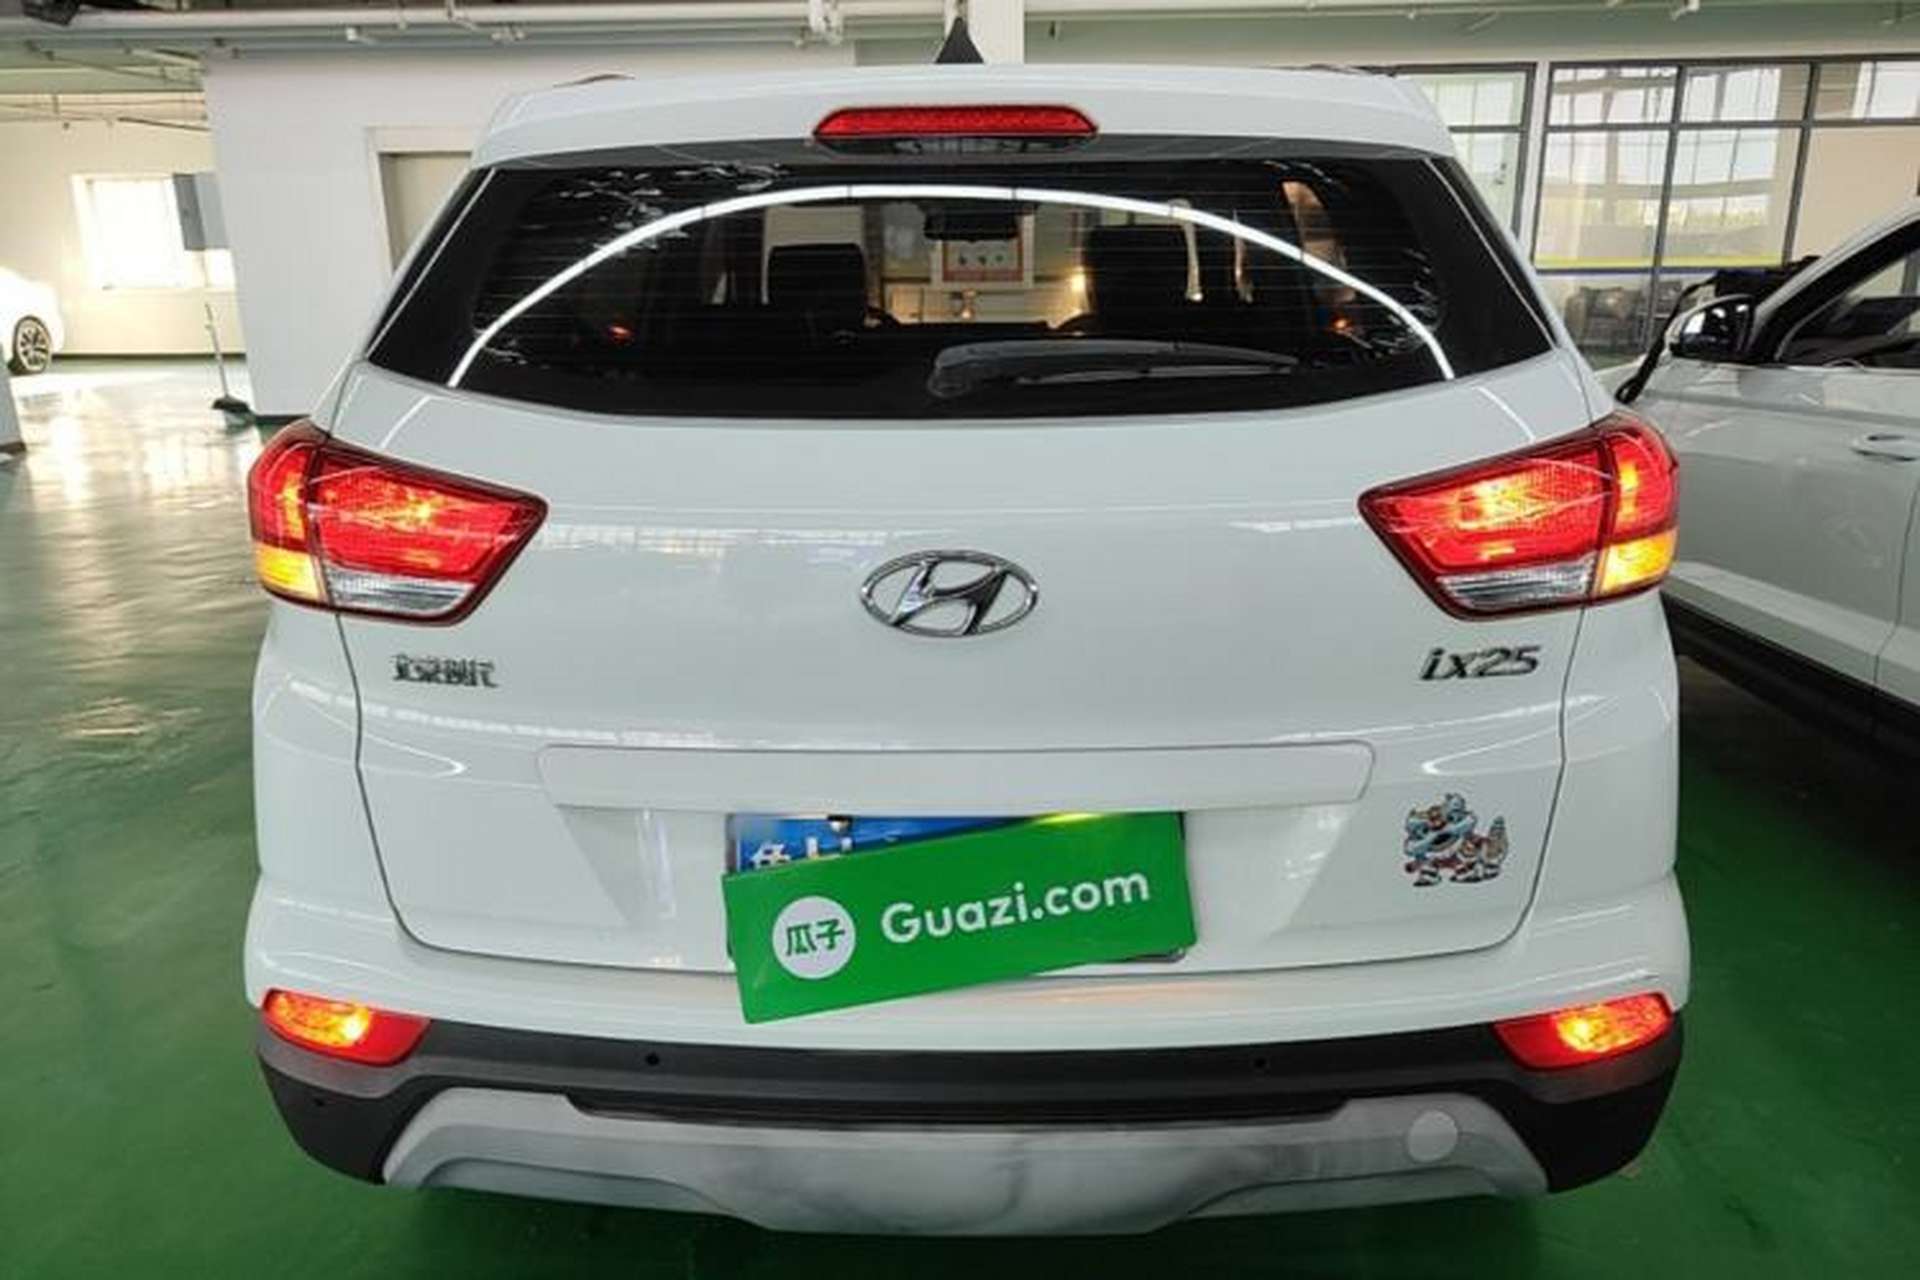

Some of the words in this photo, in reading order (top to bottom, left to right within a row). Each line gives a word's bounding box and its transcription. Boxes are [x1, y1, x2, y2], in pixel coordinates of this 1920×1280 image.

[1421, 645, 1540, 680] ix25
[880, 872, 1150, 943] Guazi.com
[786, 918, 846, 957] 瓜子
